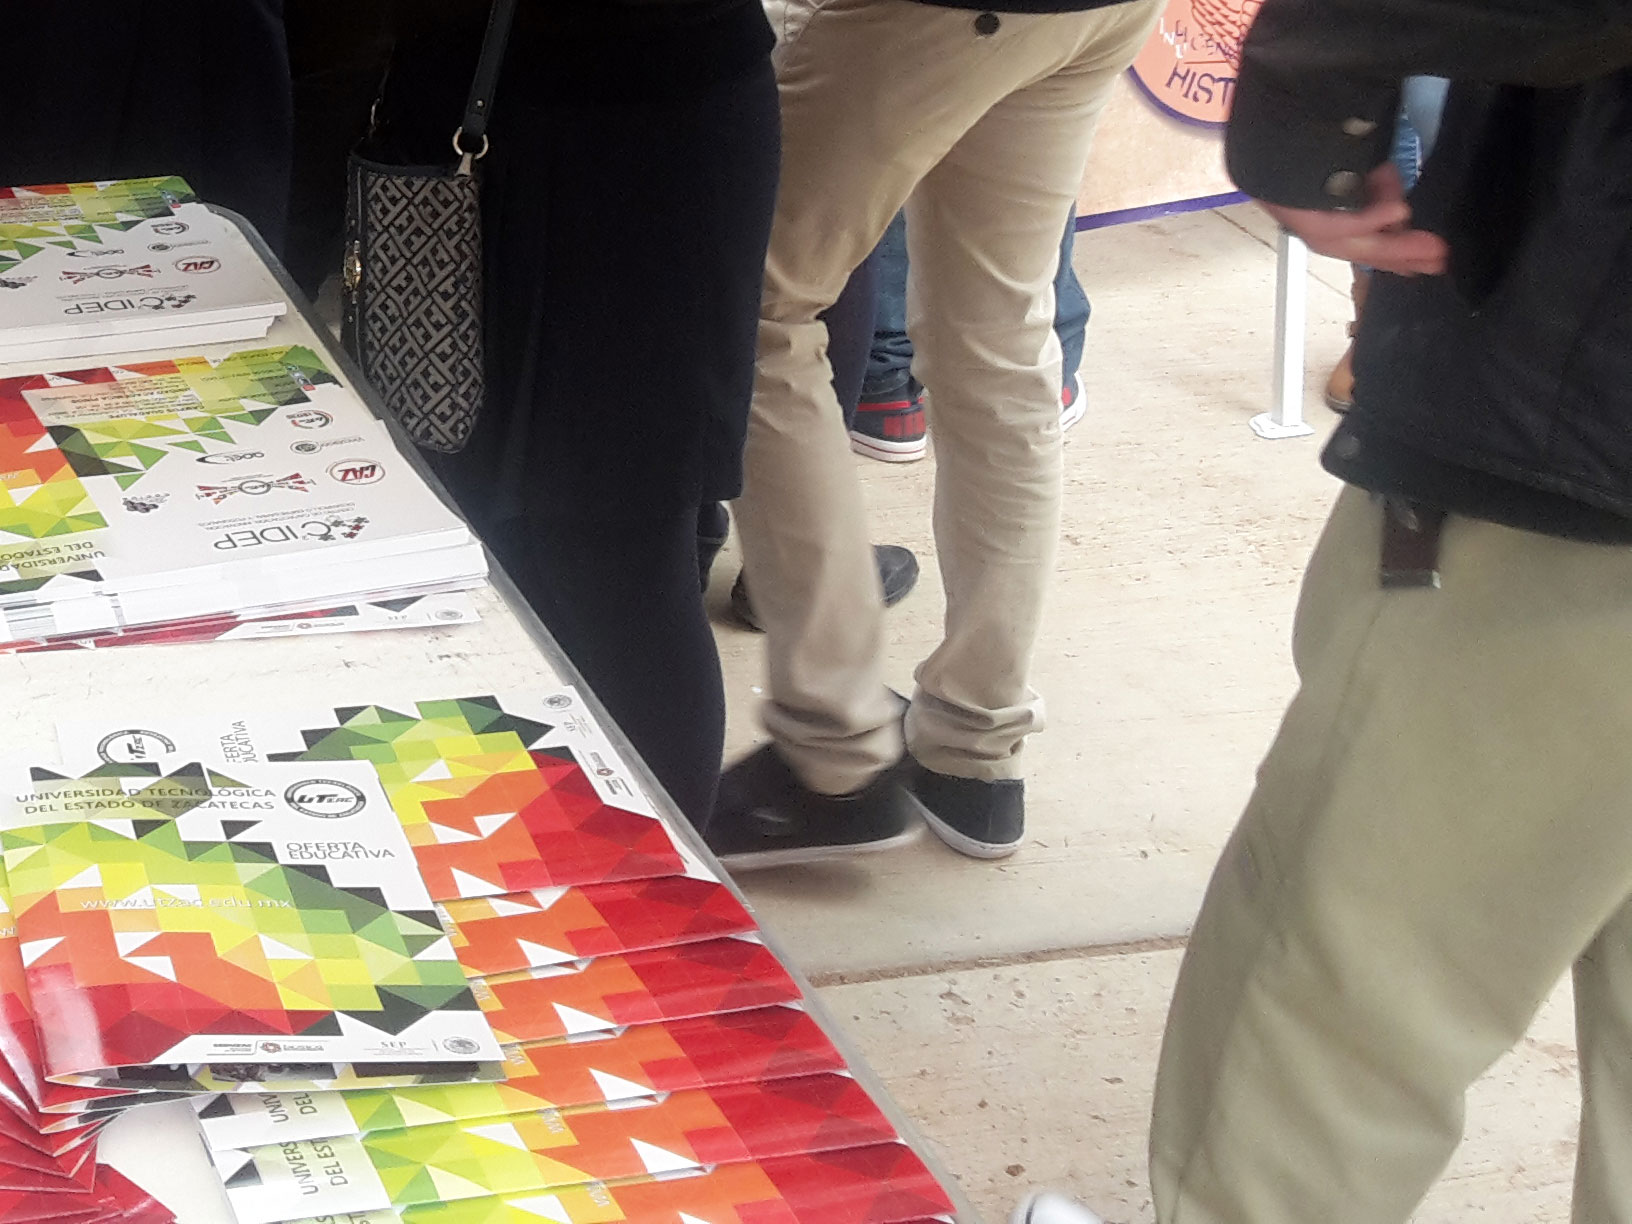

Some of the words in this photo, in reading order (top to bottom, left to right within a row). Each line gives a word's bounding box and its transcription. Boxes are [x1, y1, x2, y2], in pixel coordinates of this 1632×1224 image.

[0, 546, 60, 562] ESTADO
[63, 541, 93, 553] DEL
[16, 786, 141, 804] UNIVERSIDAD
[147, 785, 277, 798] TECNOLÓGICA
[24, 801, 59, 815] DEL
[64, 799, 135, 811] ESTADO
[172, 799, 275, 812] ZACATECAS
[287, 842, 366, 852] OFERTA
[289, 849, 396, 859] EDUCATIVA
[80, 895, 292, 910] www.utzac.edu.mx
[292, 1092, 317, 1115] DEL
[323, 1161, 349, 1187] DEL
